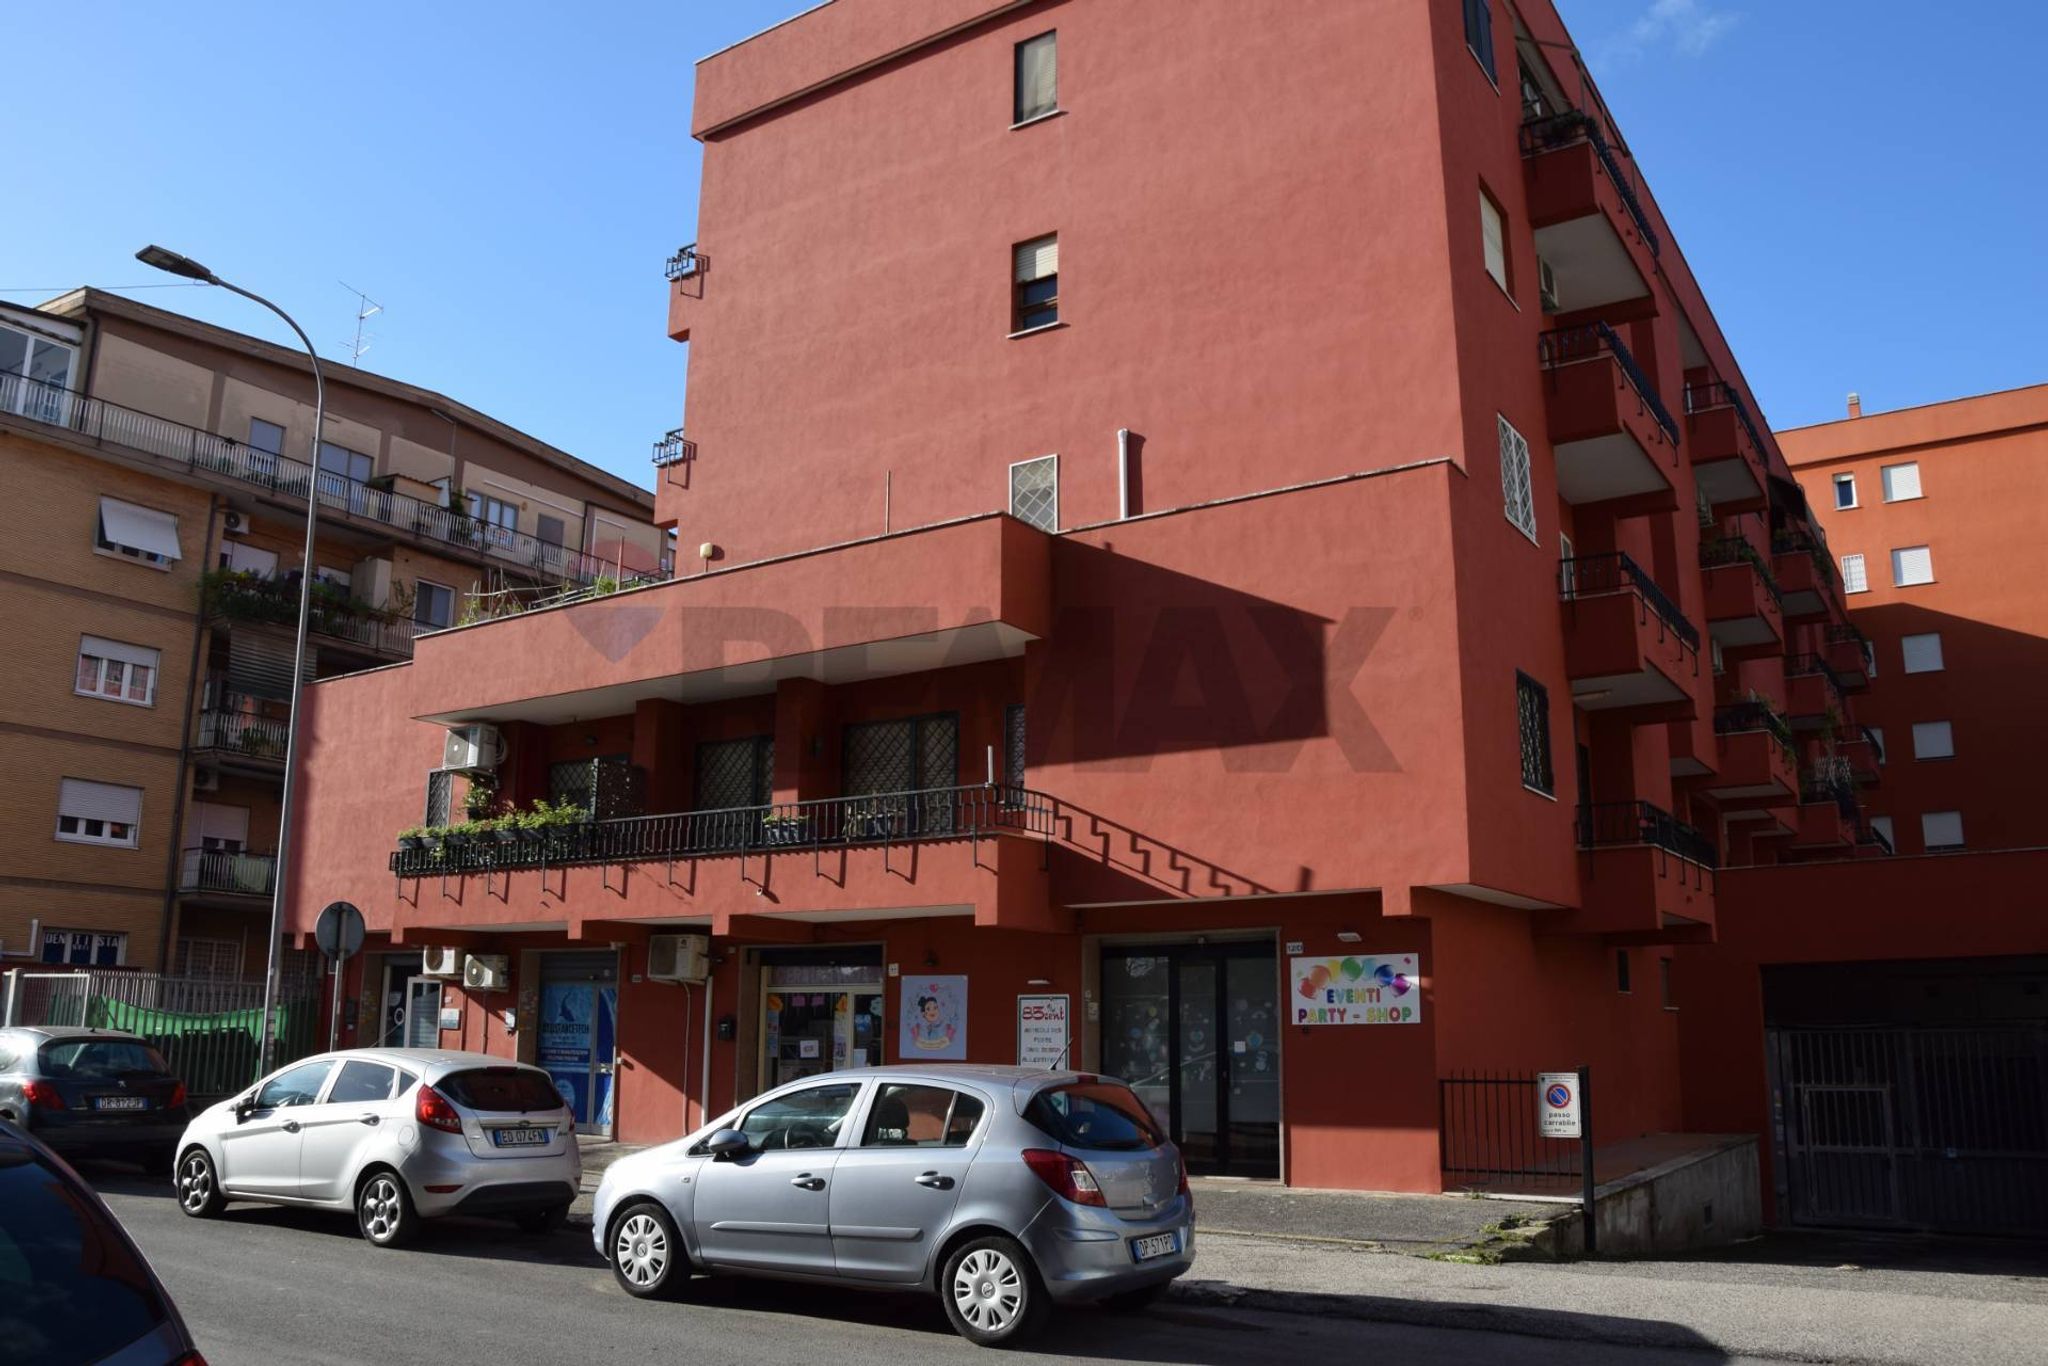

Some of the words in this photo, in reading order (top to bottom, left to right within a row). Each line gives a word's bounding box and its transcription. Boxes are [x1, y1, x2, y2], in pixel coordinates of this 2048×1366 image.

[1327, 988, 1381, 1004] EVENTI
[1298, 1008, 1347, 1023] PARTY
[1366, 1007, 1412, 1022] SHOP
